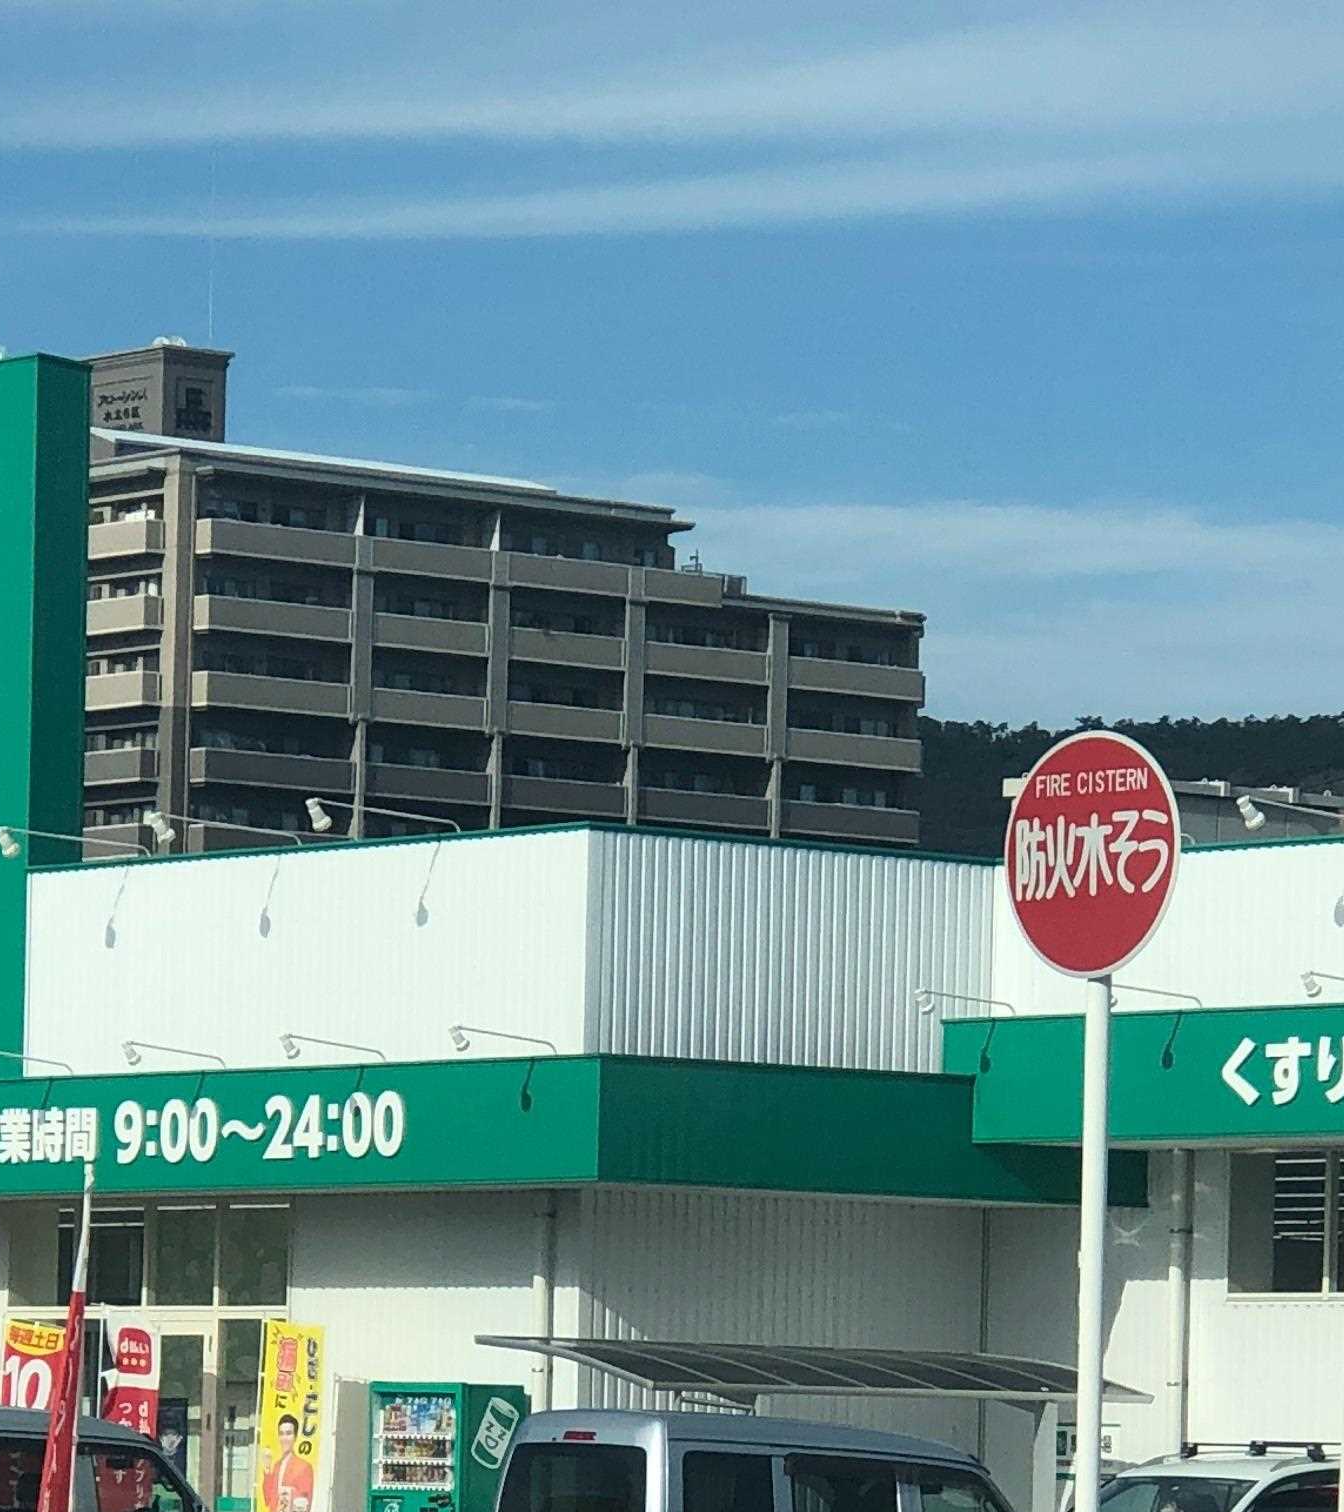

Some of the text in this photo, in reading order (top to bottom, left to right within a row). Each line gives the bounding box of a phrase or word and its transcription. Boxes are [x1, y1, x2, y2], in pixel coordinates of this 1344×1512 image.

[1035, 767, 1149, 799] FIRE CISTERN
[1015, 809, 1169, 902] 防火水そう
